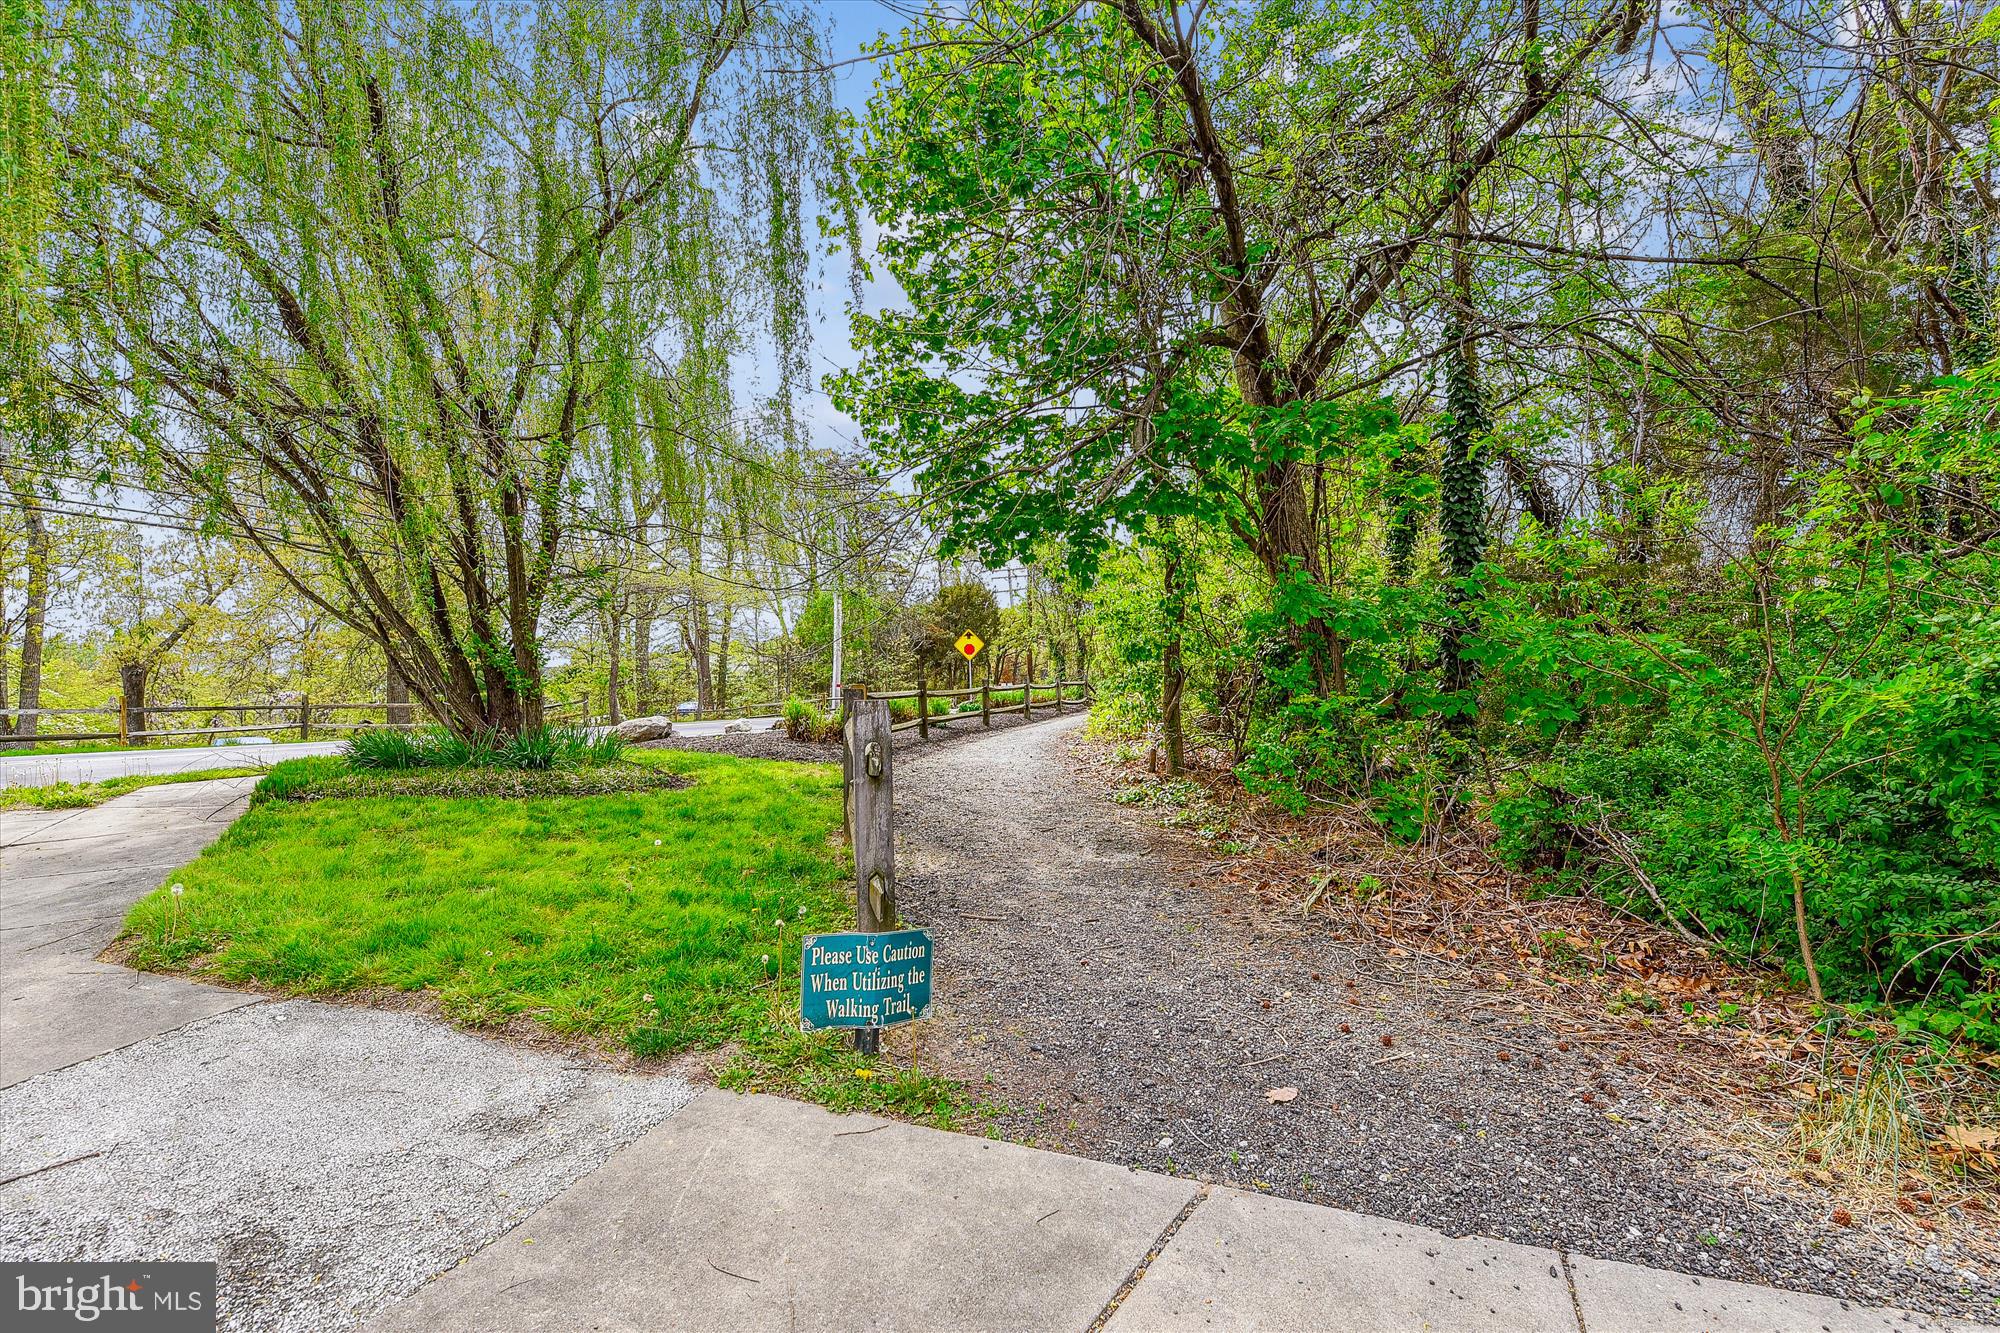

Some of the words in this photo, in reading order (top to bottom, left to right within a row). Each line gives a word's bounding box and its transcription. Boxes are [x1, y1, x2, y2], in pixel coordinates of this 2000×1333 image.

[811, 947, 852, 966] Please
[856, 945, 878, 964] Use
[883, 942, 925, 963] Caution
[811, 973, 847, 992] When
[852, 970, 904, 993] Utilizing
[908, 966, 925, 984] the
[826, 998, 879, 1024] Walking
